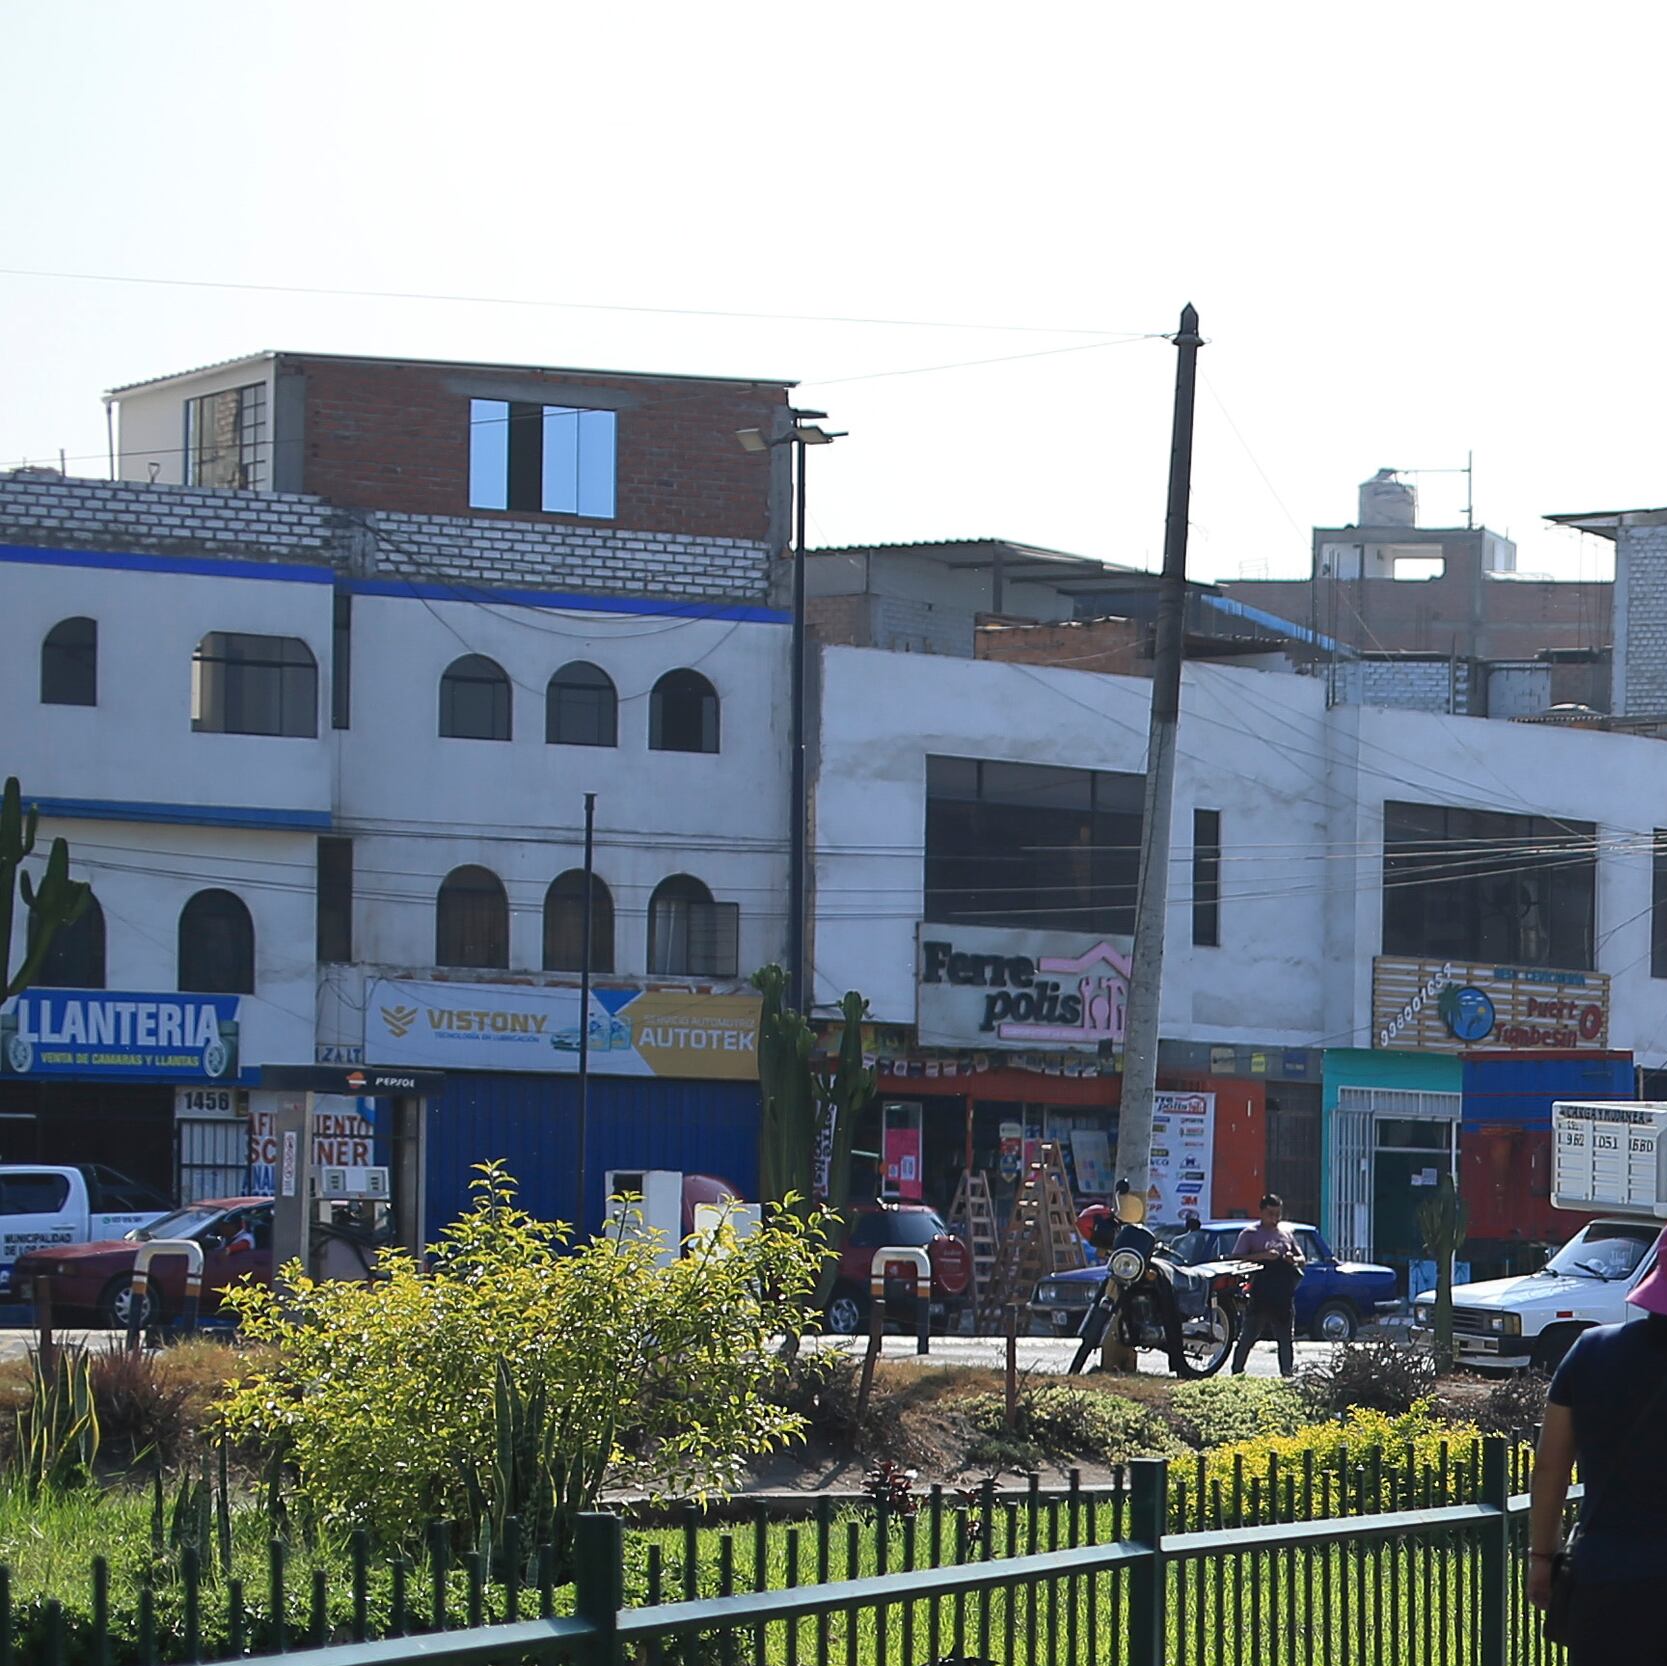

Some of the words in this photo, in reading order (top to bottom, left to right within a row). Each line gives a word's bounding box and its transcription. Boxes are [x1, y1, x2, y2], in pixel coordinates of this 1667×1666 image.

[923, 941, 1035, 987] Ferre
[979, 981, 1081, 1031] polis
[17, 998, 220, 1047] LLANTERIA
[427, 1008, 548, 1034] VISTONY
[639, 1027, 756, 1051] AUTOTEK
[40, 1052, 73, 1065] VENTA
[76, 1053, 89, 1065] DE
[92, 1053, 143, 1066] CAMARAS
[146, 1055, 153, 1067] Y
[155, 1055, 200, 1067] LLANTAS
[184, 1091, 230, 1112] 1456
